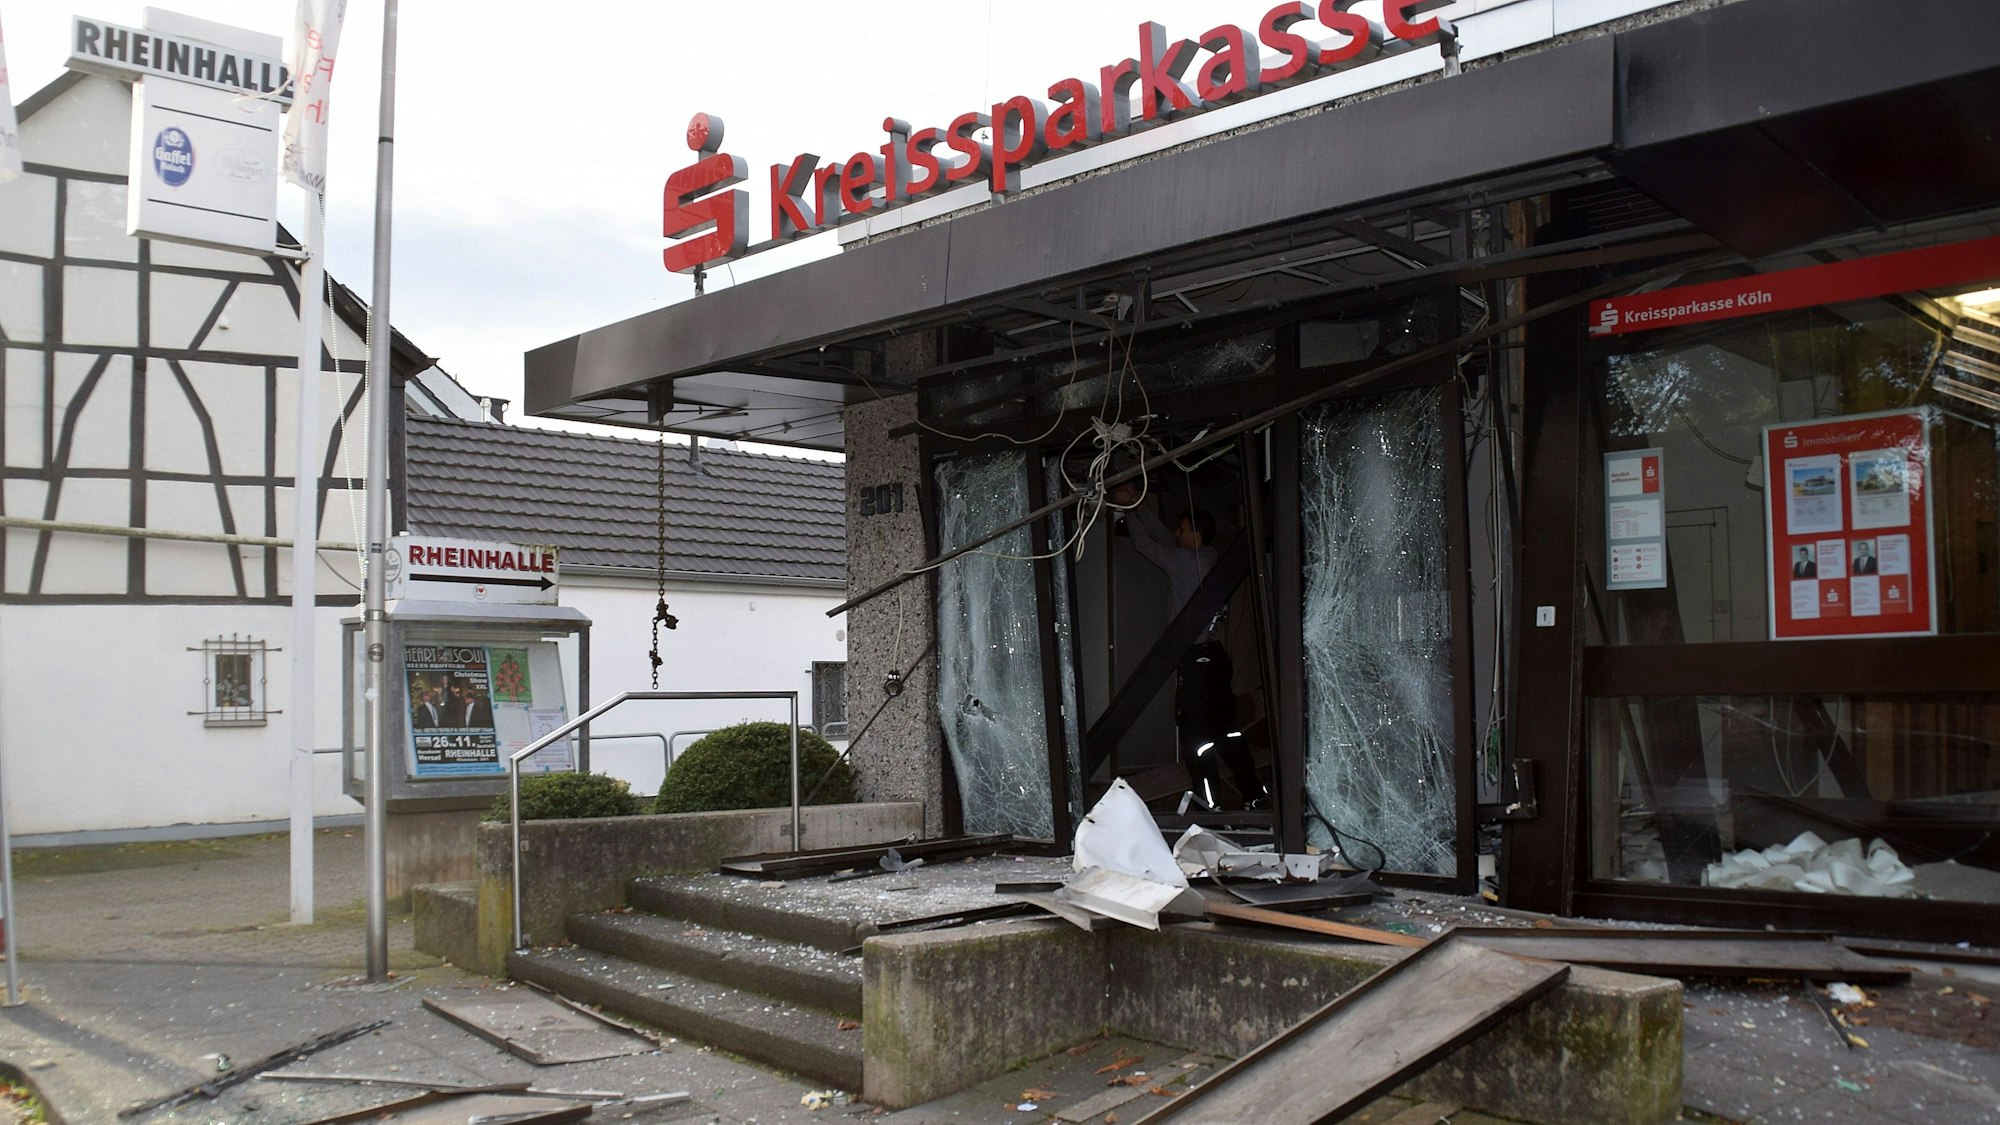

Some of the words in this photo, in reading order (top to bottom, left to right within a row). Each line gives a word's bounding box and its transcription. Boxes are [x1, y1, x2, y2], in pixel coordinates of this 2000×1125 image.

[771, 0, 1445, 242] Kreissparkasse
[155, 146, 191, 166] Gaffel
[1624, 300, 1733, 323] Kreissparkasse
[1738, 290, 1772, 307] Köln
[1803, 432, 1860, 447] Immobilien
[860, 481, 903, 517] 201
[409, 545, 555, 573] RHEINHALLE
[405, 647, 437, 663] HEART
[453, 648, 487, 663] SOUL
[445, 748, 496, 758] RHEINHALLE
